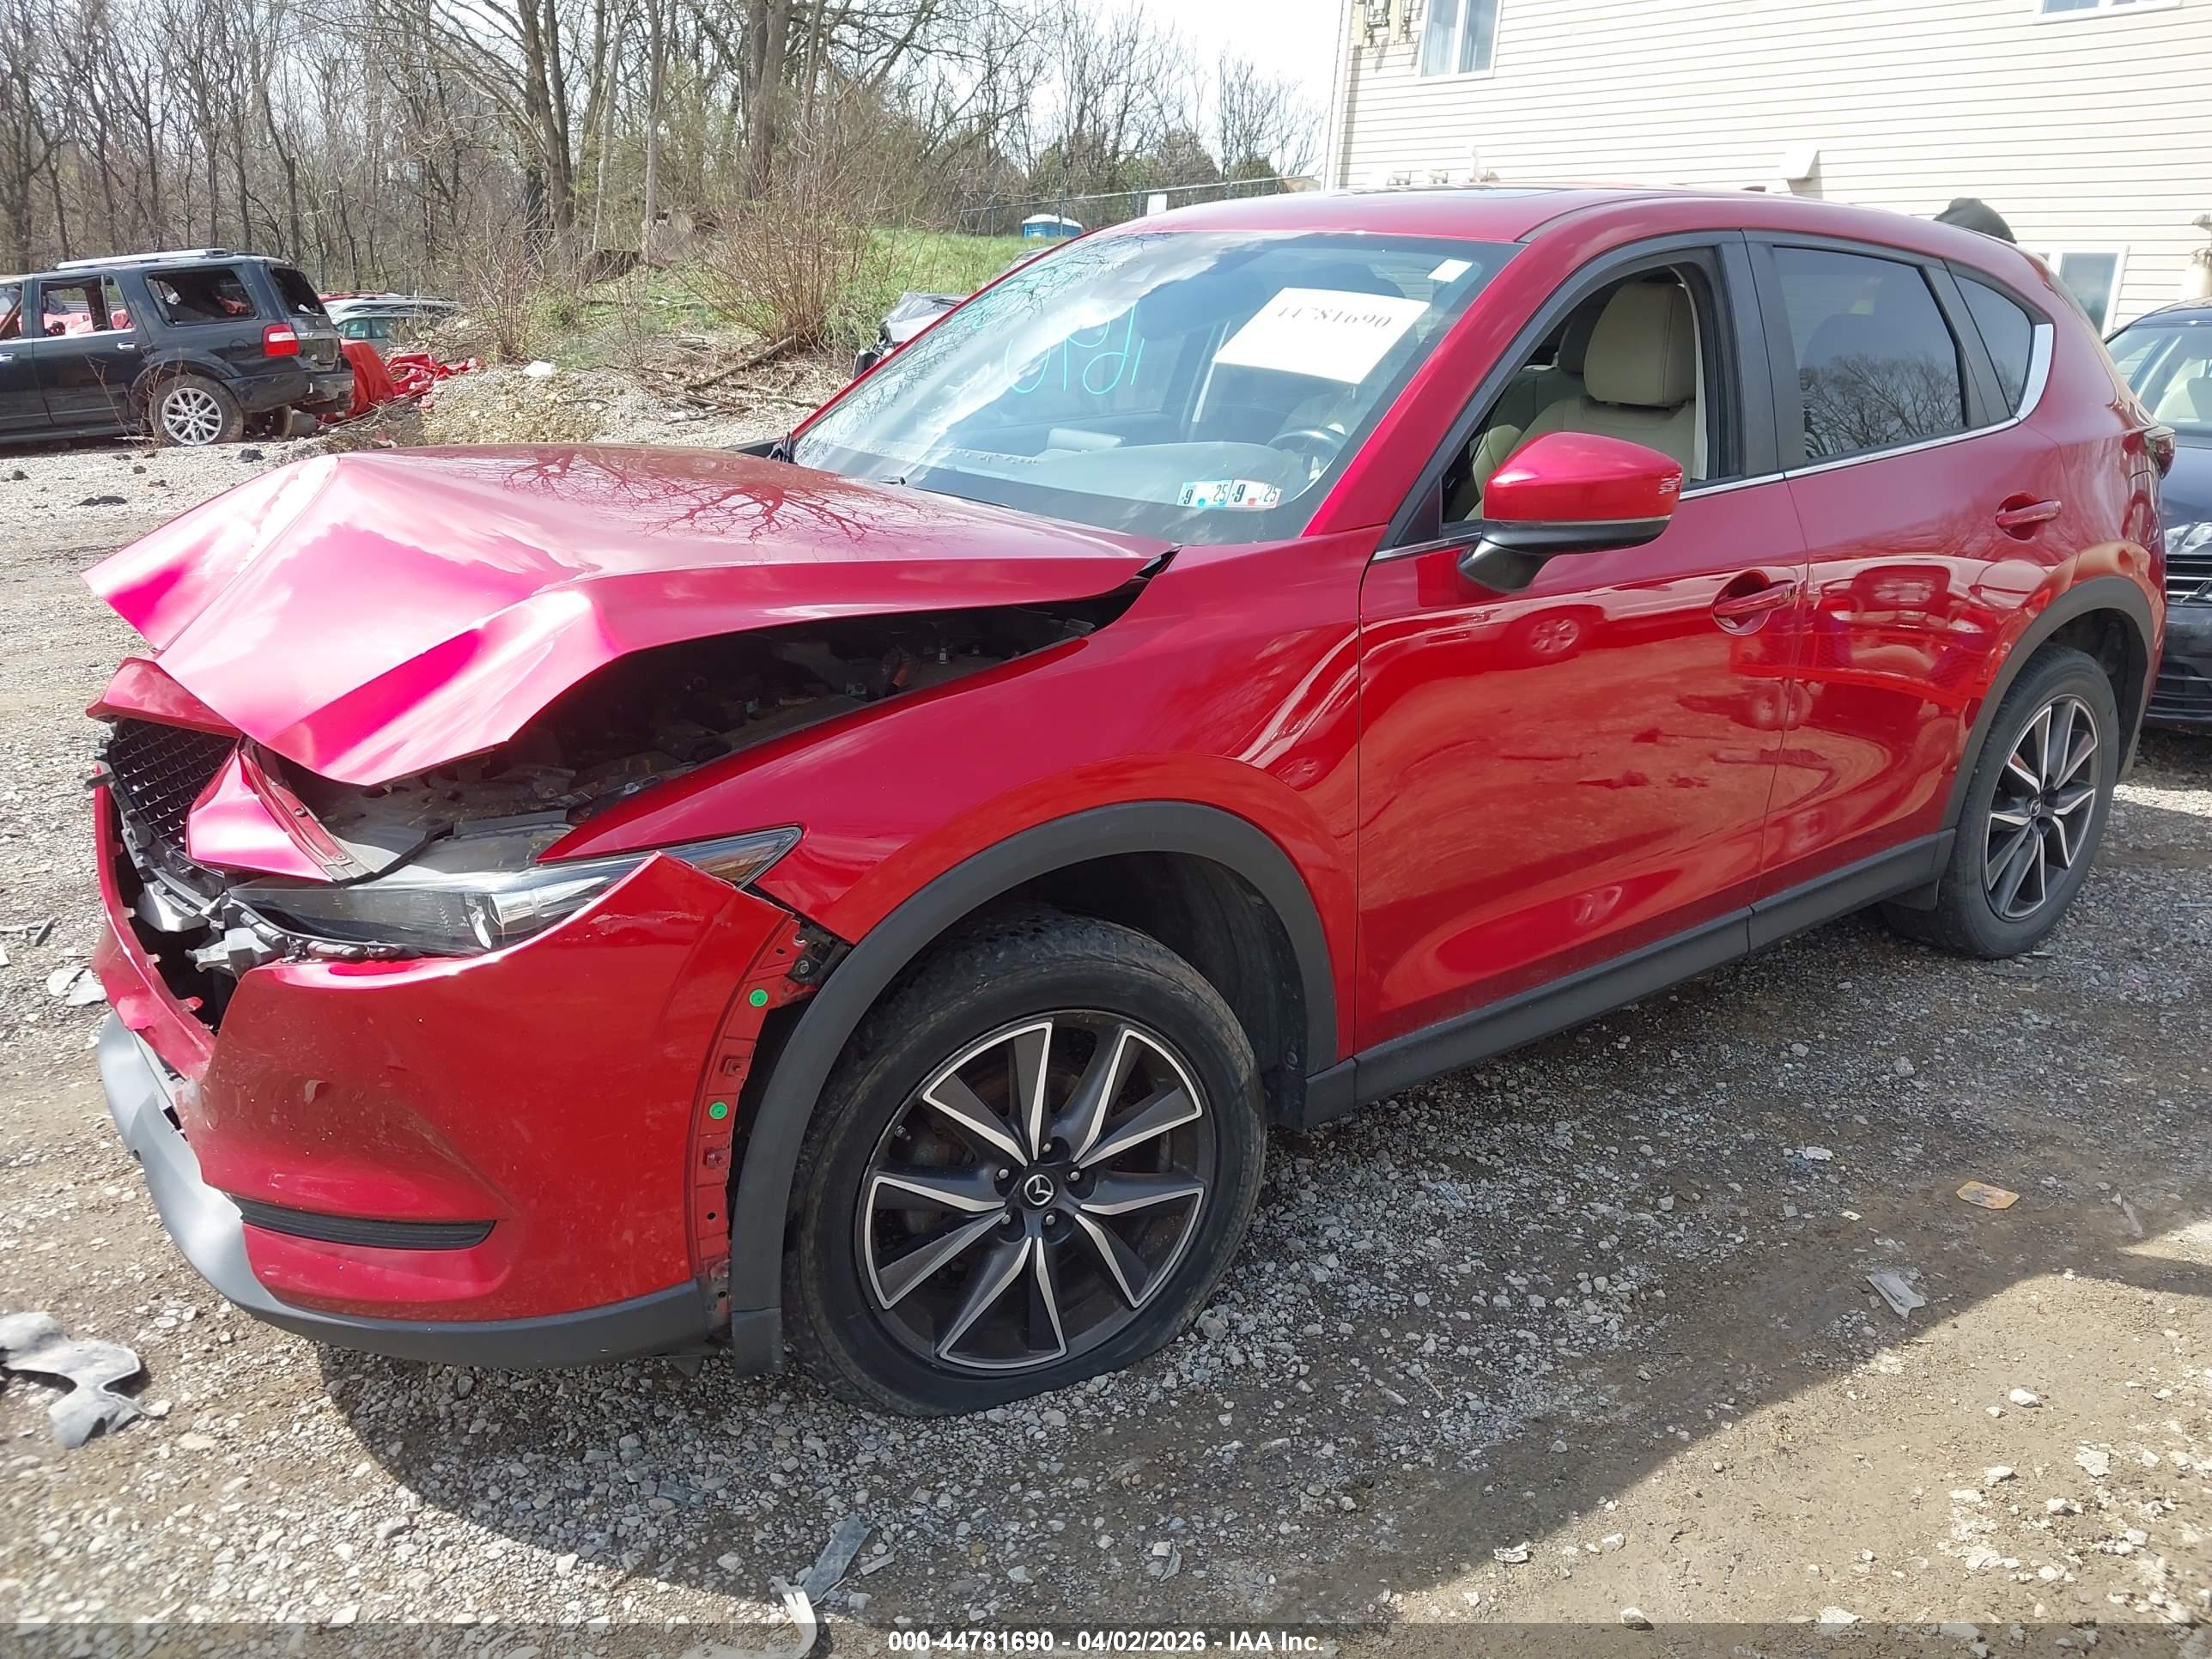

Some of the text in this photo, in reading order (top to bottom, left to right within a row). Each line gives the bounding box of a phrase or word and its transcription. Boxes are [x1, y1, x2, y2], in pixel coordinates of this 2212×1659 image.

[1183, 483, 1229, 505] 9 25
[1234, 483, 1278, 503] 9 25
